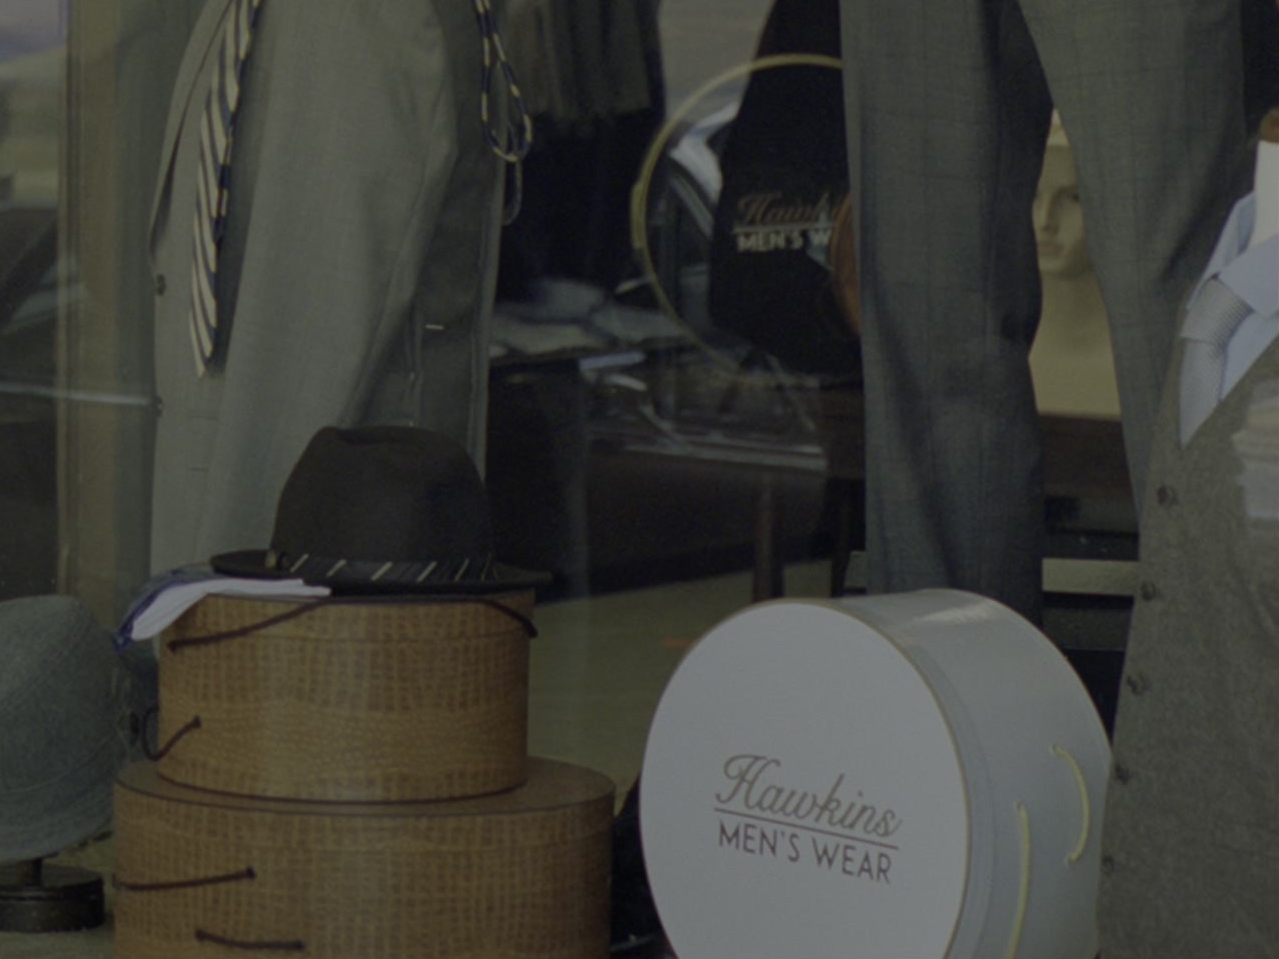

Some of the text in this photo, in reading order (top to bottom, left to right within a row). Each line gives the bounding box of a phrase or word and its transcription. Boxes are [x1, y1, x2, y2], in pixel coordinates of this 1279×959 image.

[715, 754, 903, 837] Hawkins
[718, 819, 891, 884] MEN'S WEAR
